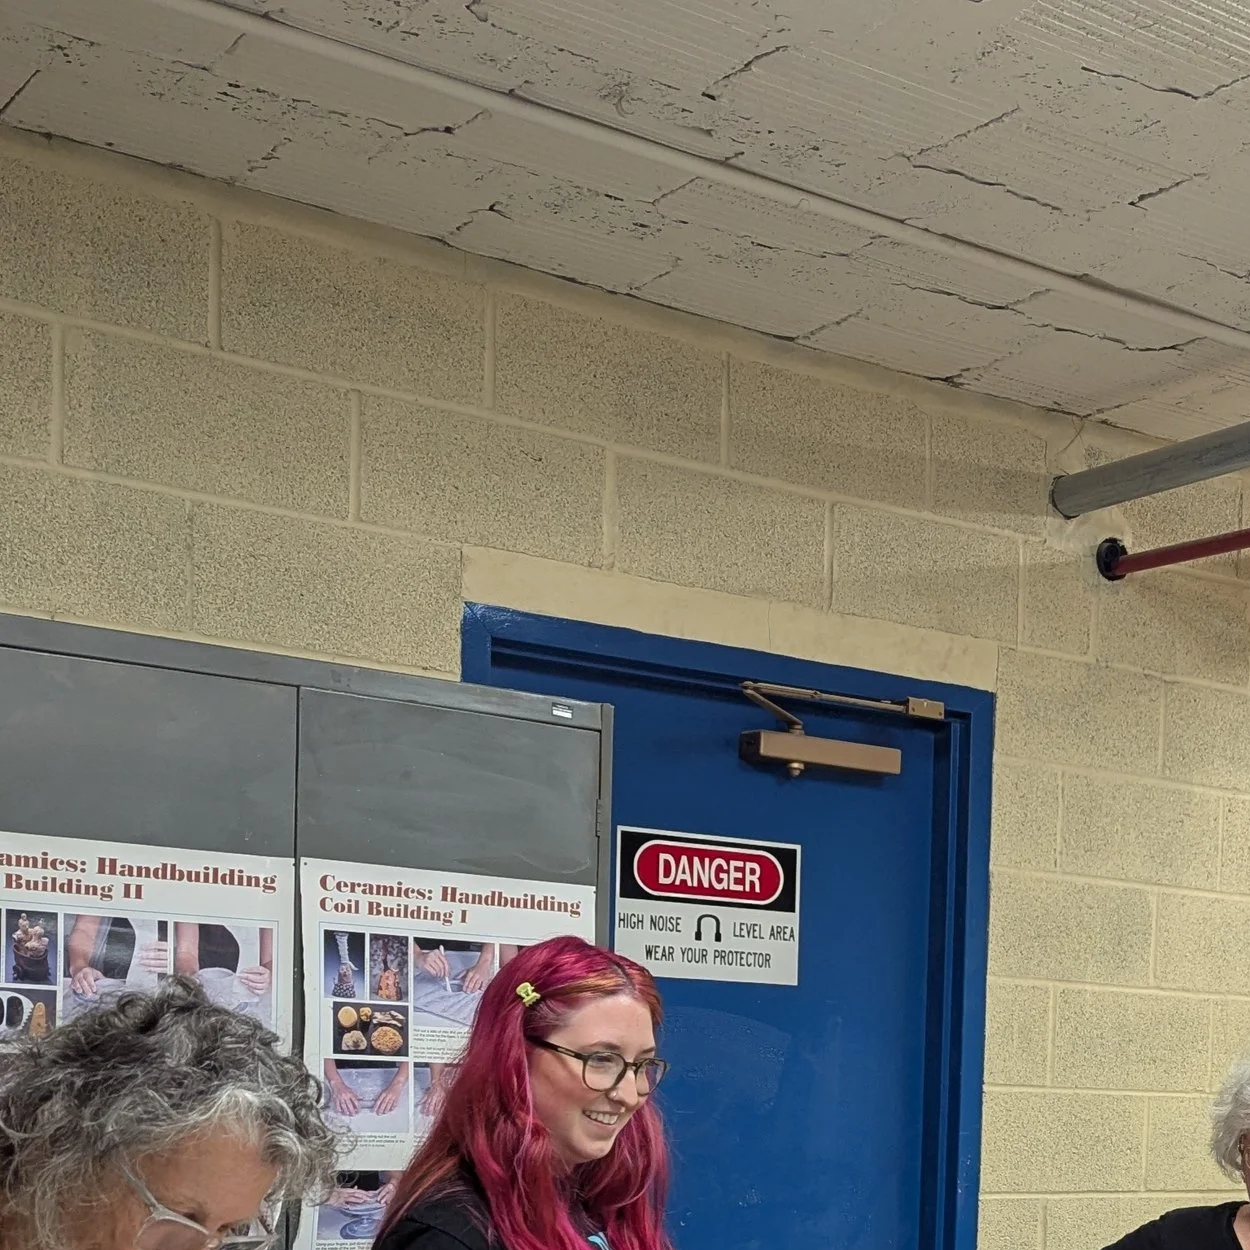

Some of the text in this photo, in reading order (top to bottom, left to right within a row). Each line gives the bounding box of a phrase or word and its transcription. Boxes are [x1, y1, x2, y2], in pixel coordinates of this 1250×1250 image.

[0, 851, 277, 894] amics: Handbuilding
[4, 872, 144, 901] Building II
[658, 852, 761, 893] DANGER
[319, 874, 582, 918] Ceramics: Handbuilding
[319, 896, 468, 926] Coil Building I
[618, 912, 795, 942] HIGH NOISE LEVEL AREA
[645, 944, 771, 969] WEAR YOUR PROTECTOR
